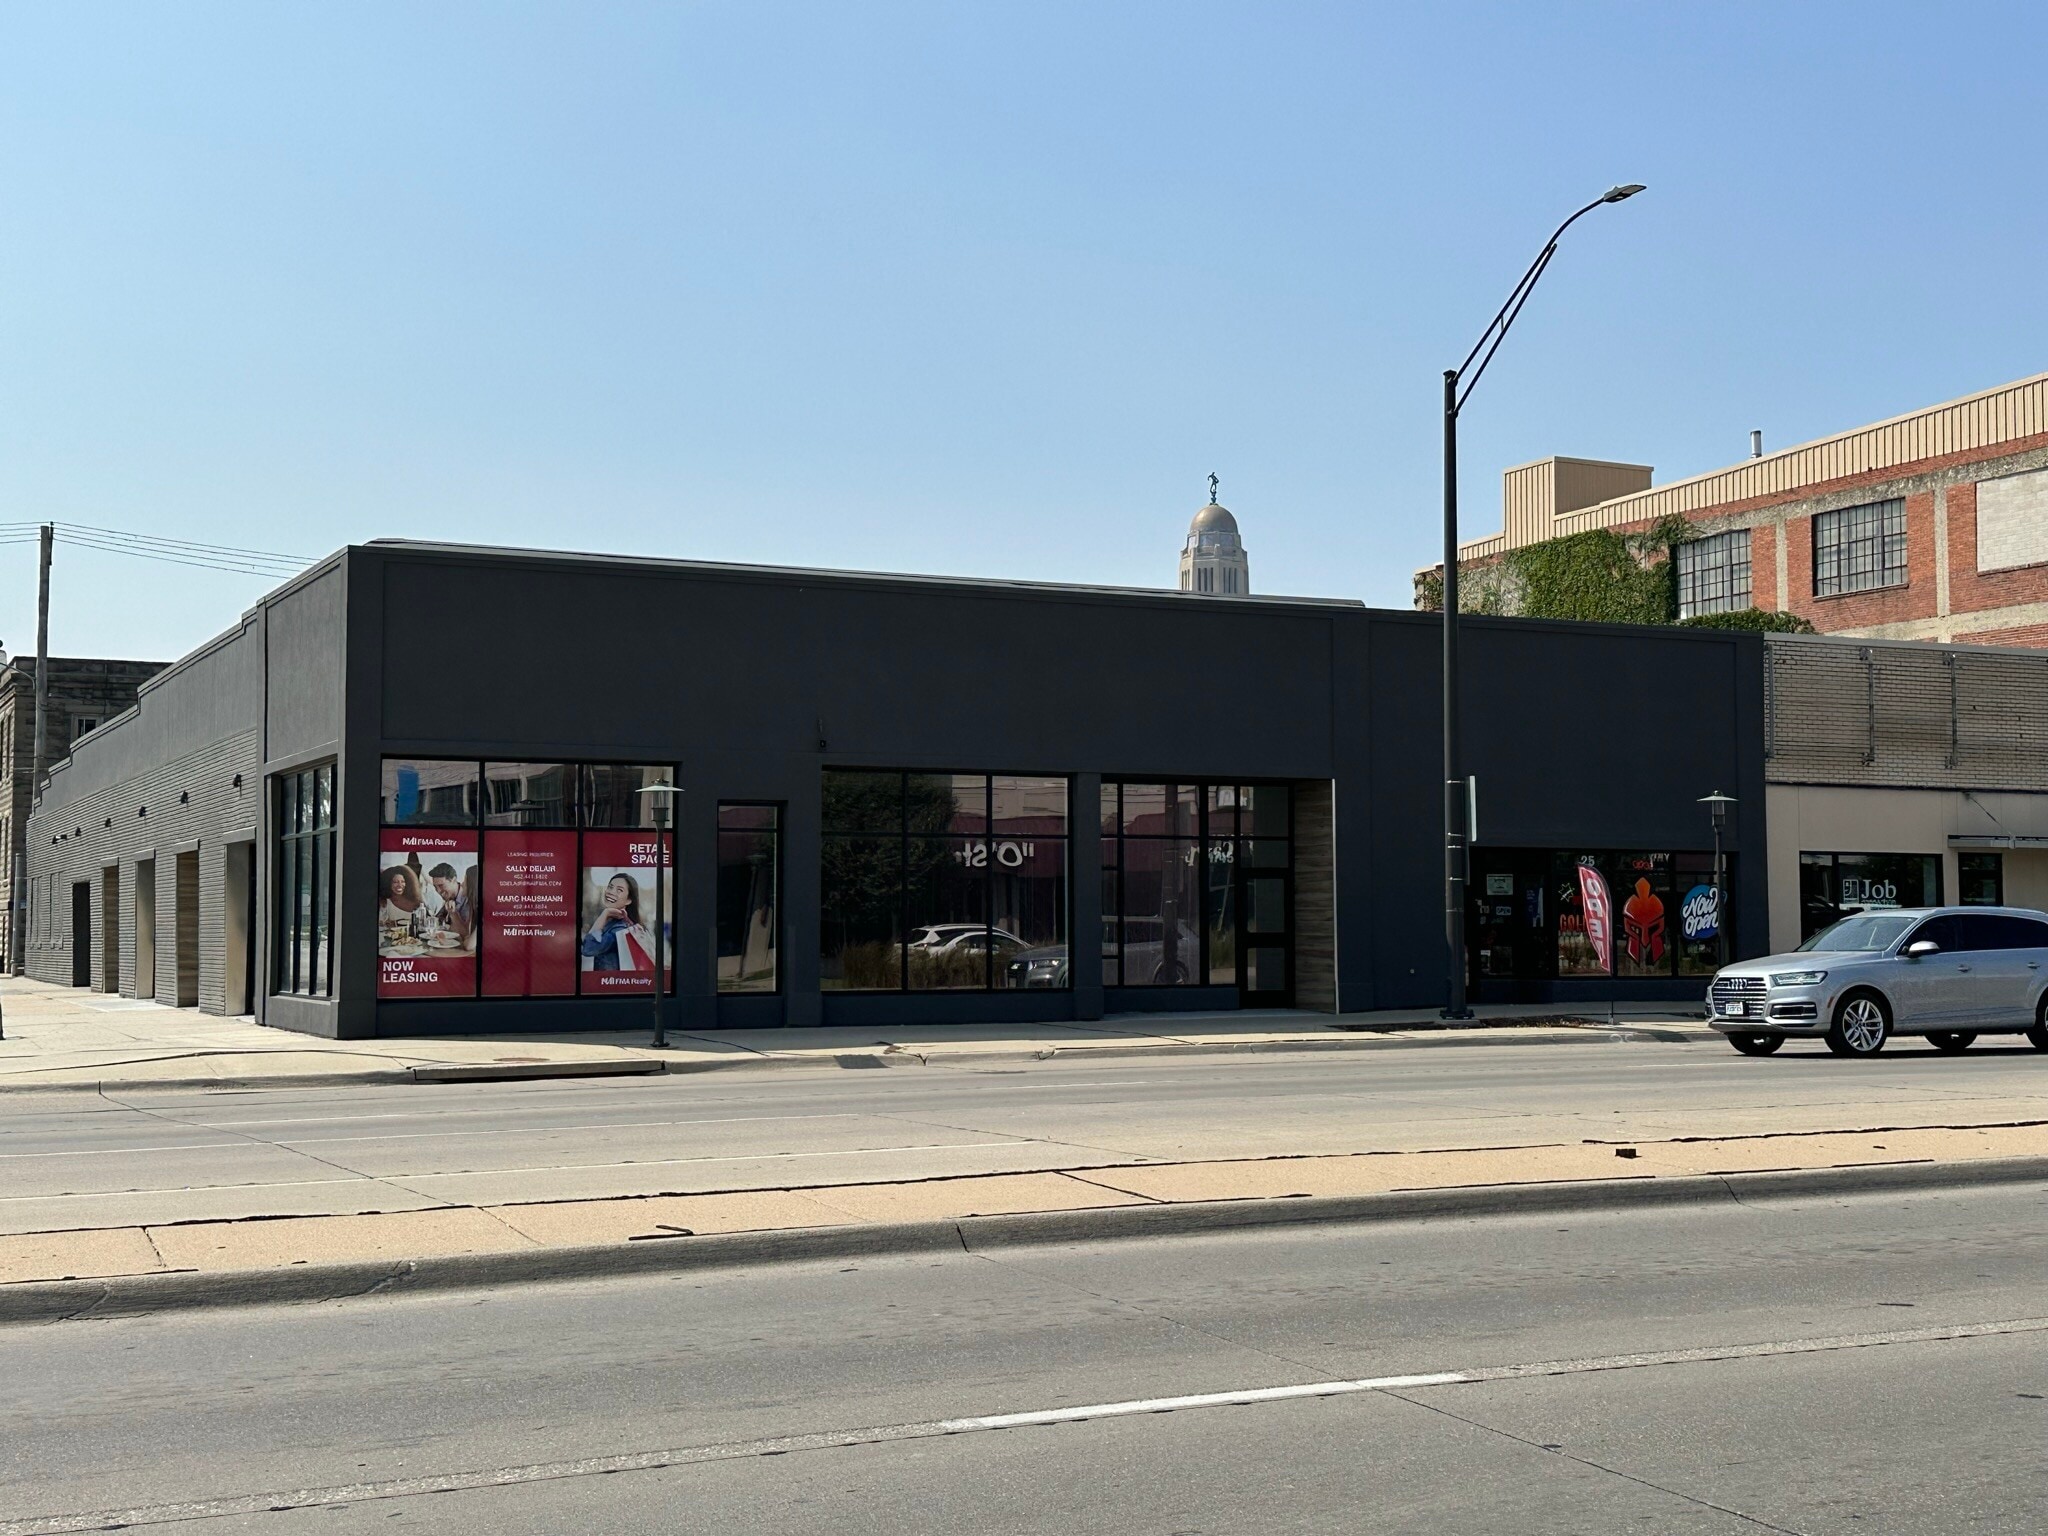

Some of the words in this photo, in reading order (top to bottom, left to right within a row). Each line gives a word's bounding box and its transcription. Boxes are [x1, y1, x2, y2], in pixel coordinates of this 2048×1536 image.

[417, 838, 434, 846] FMA
[434, 838, 457, 847] Realty
[629, 843, 670, 854] RETAL
[1861, 879, 1897, 899] Job
[1683, 886, 1718, 918] Now
[534, 929, 556, 937] Realty
[383, 961, 414, 972] NOW
[383, 972, 438, 983] LEASING
[631, 978, 652, 986] Realty
